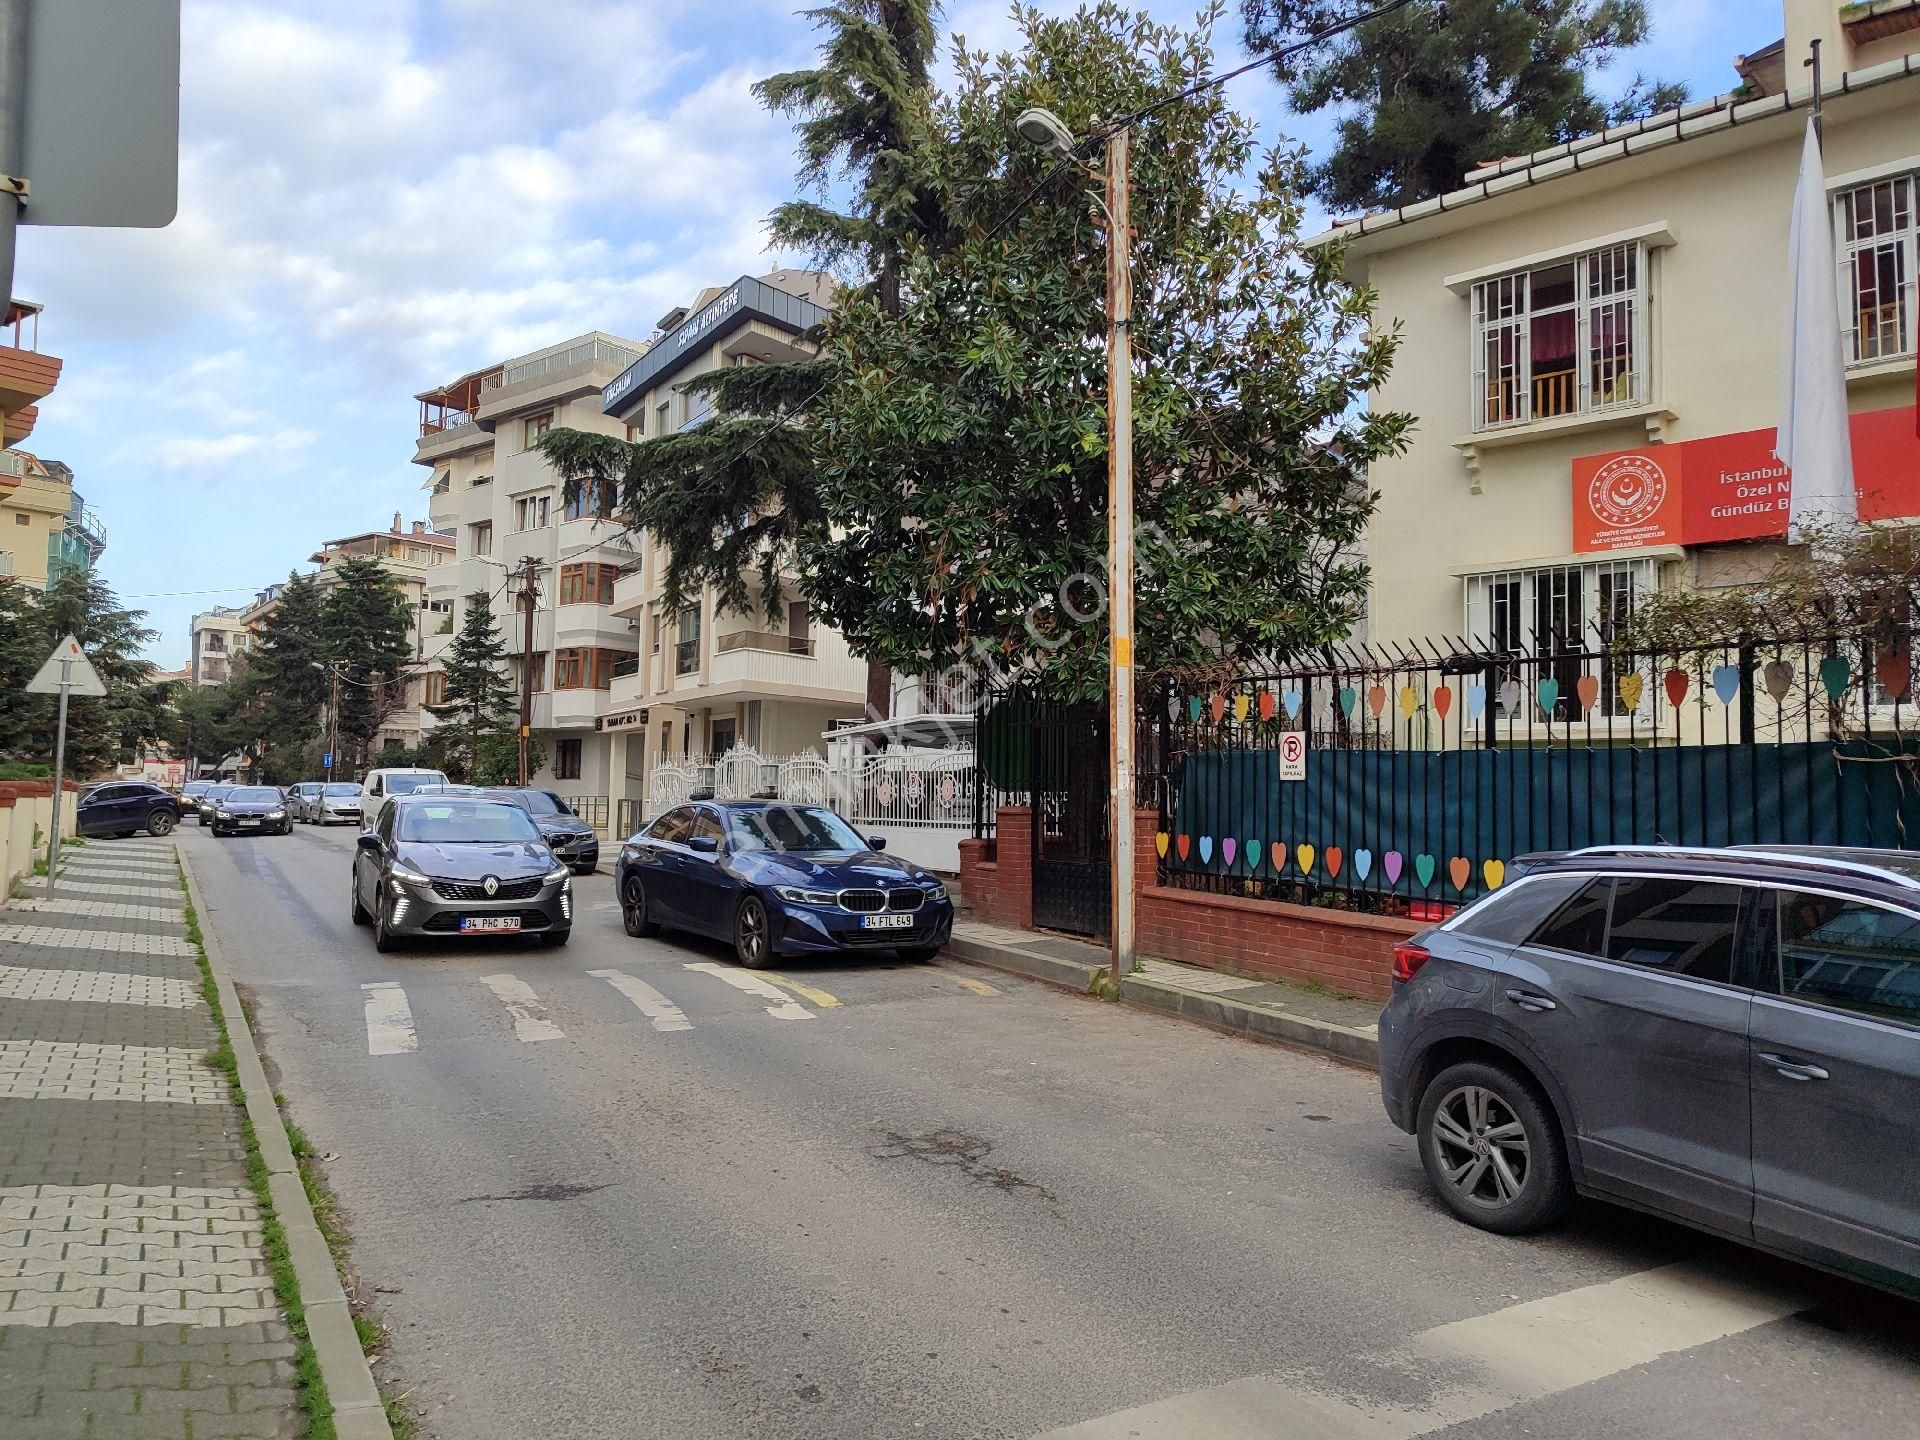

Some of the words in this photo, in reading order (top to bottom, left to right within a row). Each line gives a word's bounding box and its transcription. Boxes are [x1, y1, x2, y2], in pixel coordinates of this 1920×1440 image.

[1720, 464, 1788, 484] İstanbul
[1736, 483, 1772, 498] Özel
[1711, 501, 1773, 518] Gündüz
[466, 919, 477, 929] 34
[482, 918, 499, 928] PHC
[503, 918, 519, 928] 570
[866, 916, 876, 927] 34
[879, 916, 894, 927] FTL
[896, 915, 911, 926] 649
